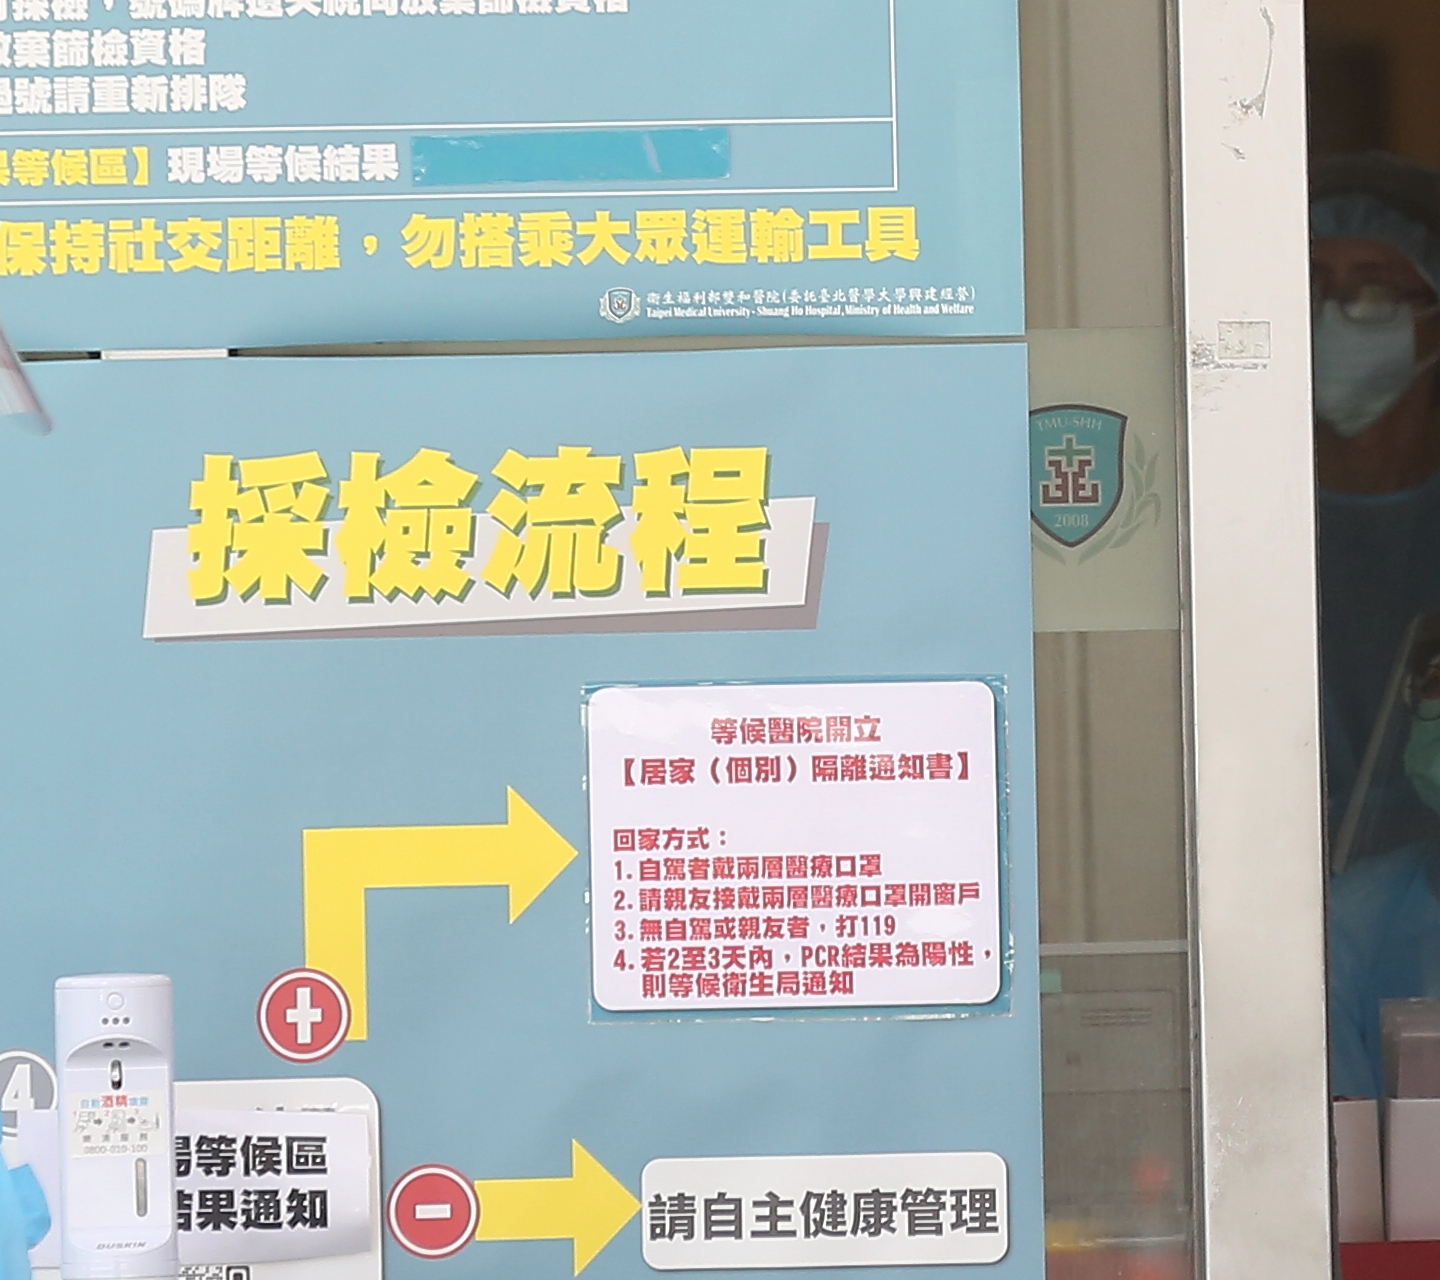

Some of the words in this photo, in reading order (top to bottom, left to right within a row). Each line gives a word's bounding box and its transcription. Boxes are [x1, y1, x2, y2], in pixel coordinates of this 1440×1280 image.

[187, 445, 772, 604] 採檢流程
[711, 716, 882, 745] 等候醫院開立
[650, 1188, 1000, 1242] 請自主健康管理
